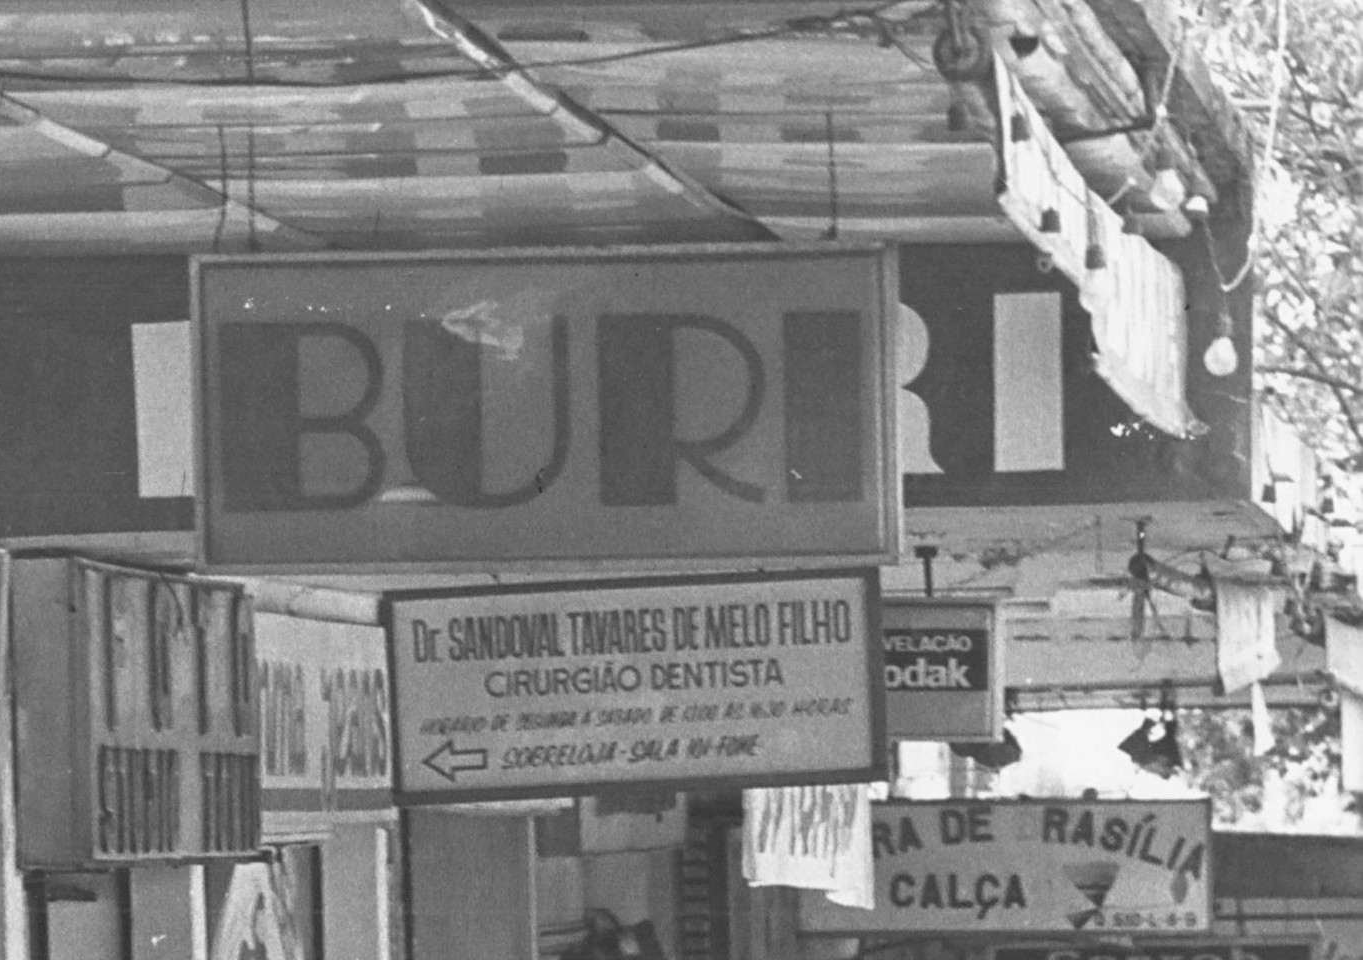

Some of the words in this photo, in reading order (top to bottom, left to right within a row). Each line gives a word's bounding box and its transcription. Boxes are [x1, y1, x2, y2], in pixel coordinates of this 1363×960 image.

[216, 311, 865, 512] BURI
[448, 614, 566, 662] SANDOVAL
[567, 608, 667, 656] TAVARES
[672, 606, 700, 651] DE
[704, 603, 770, 648] MELO
[778, 599, 850, 645] FILHO
[485, 661, 641, 698] CIRURGIÃO
[650, 657, 784, 691] DENTISTA
[884, 657, 972, 687] odak
[940, 805, 994, 846] DE
[1040, 804, 1204, 881] RASÍLIA
[889, 871, 1027, 920] CALÇA
